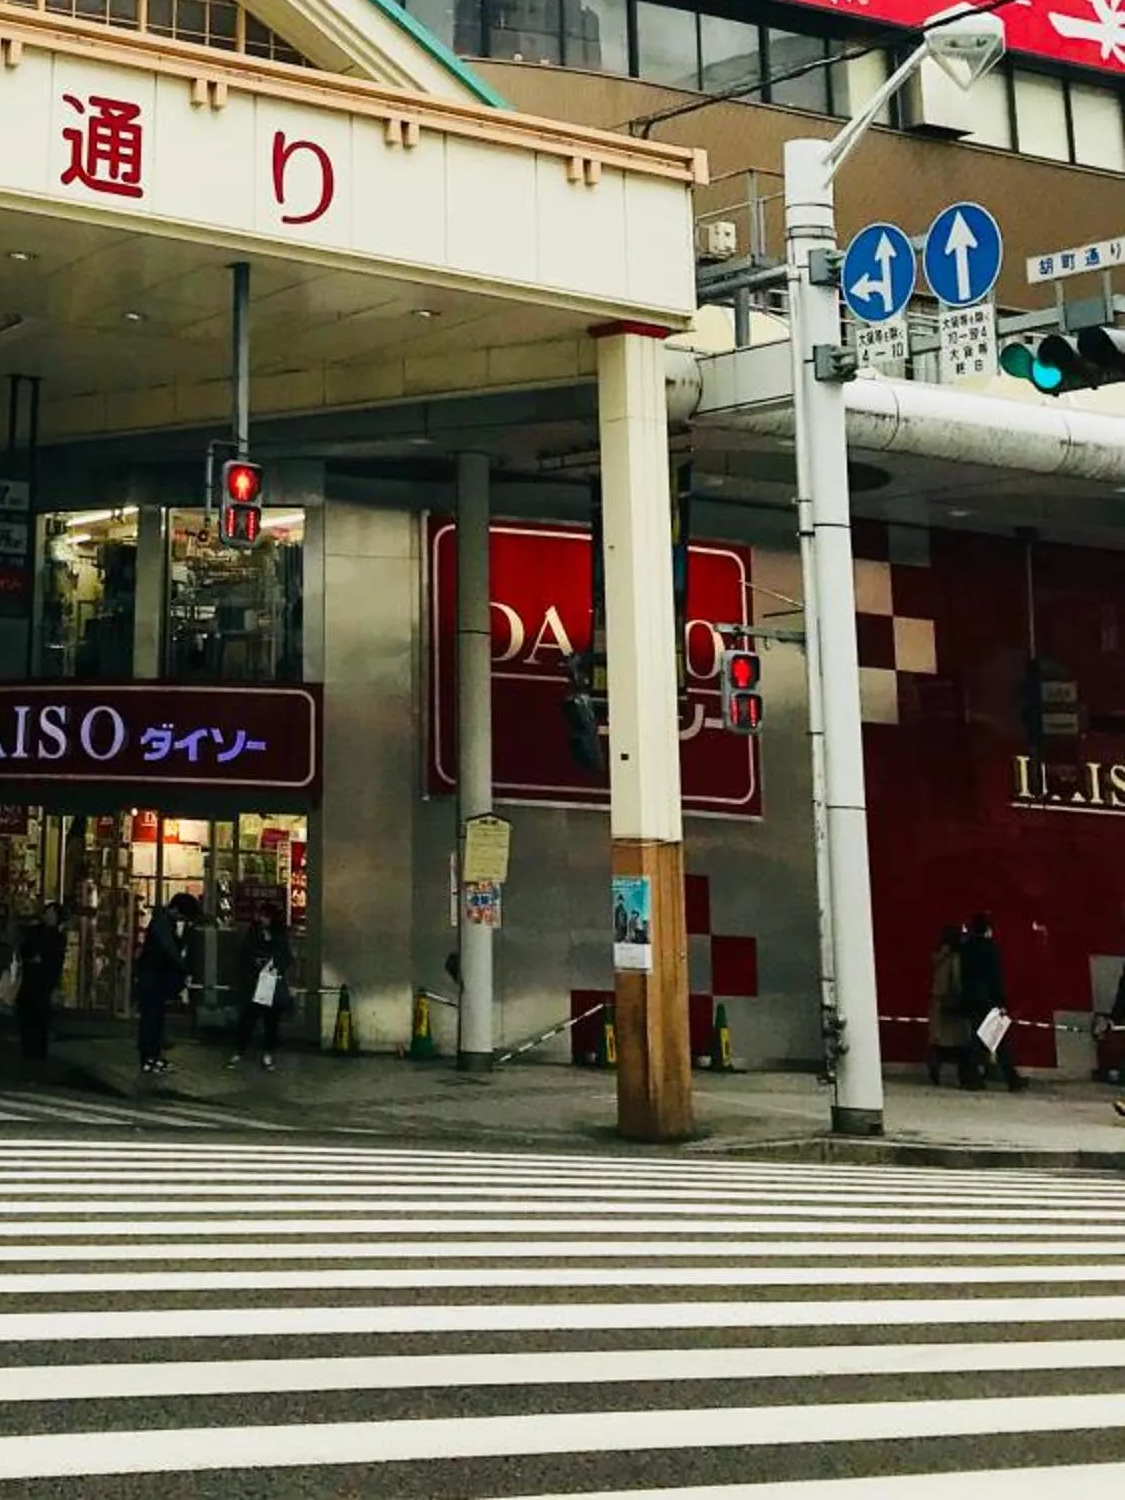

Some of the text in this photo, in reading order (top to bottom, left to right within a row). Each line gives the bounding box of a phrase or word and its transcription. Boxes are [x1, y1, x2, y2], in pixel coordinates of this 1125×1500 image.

[490, 601, 726, 680] DAO
[140, 723, 267, 763] ダイソー
